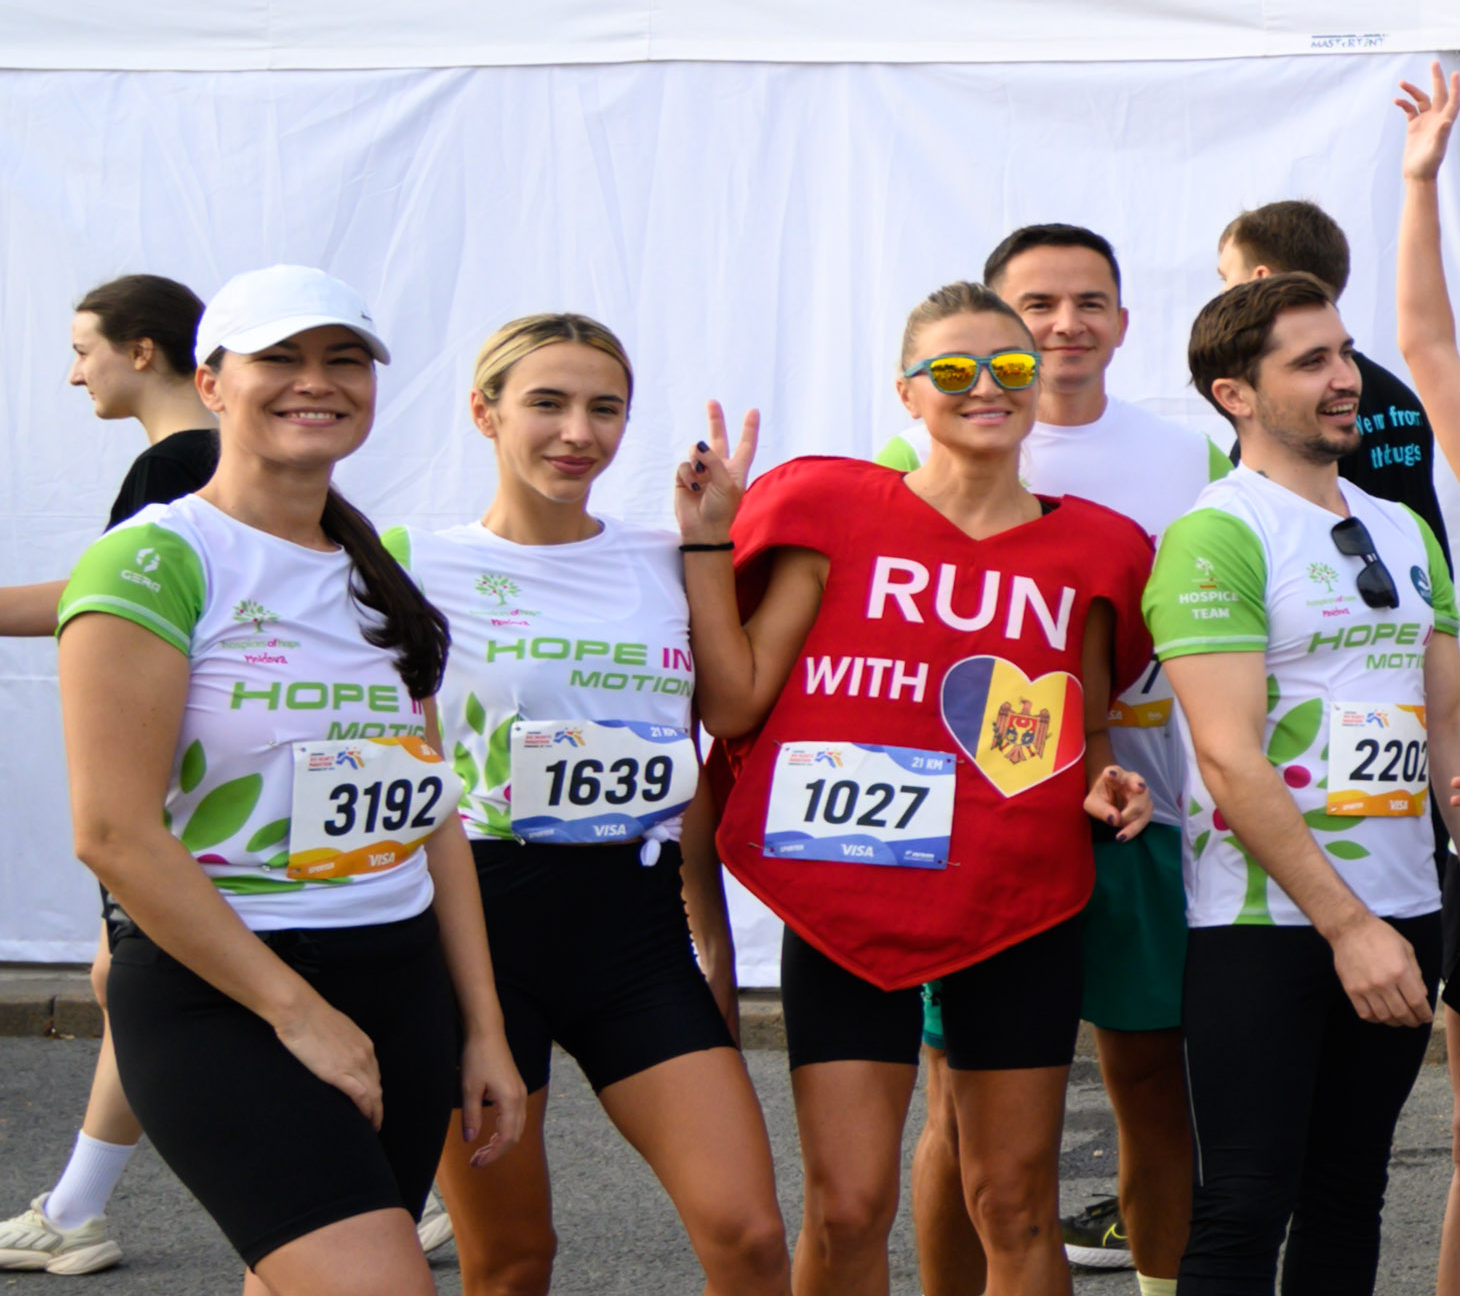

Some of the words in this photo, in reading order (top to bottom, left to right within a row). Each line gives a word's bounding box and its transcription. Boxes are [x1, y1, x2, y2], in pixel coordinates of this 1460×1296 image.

[120, 569, 162, 593] GERA
[866, 555, 1077, 652] RUN
[1179, 591, 1239, 604] HOSPICE
[1192, 608, 1231, 620] TEAM
[1307, 622, 1421, 654] HOPE
[485, 636, 648, 666] HOPE
[662, 646, 693, 673] IN
[1365, 652, 1425, 670] MOTI
[569, 669, 693, 699] MOTION
[805, 655, 930, 704] WITH
[230, 681, 400, 713] HOPE
[650, 726, 664, 738] 21
[912, 756, 924, 769] 21
[926, 758, 944, 772] KM
[1348, 738, 1427, 783] 2202
[546, 755, 674, 807] 1639
[323, 775, 444, 837] 3192
[803, 778, 931, 830] 1027
[592, 823, 627, 837] VISA
[367, 852, 396, 868] VISA
[841, 843, 875, 858] VISA
